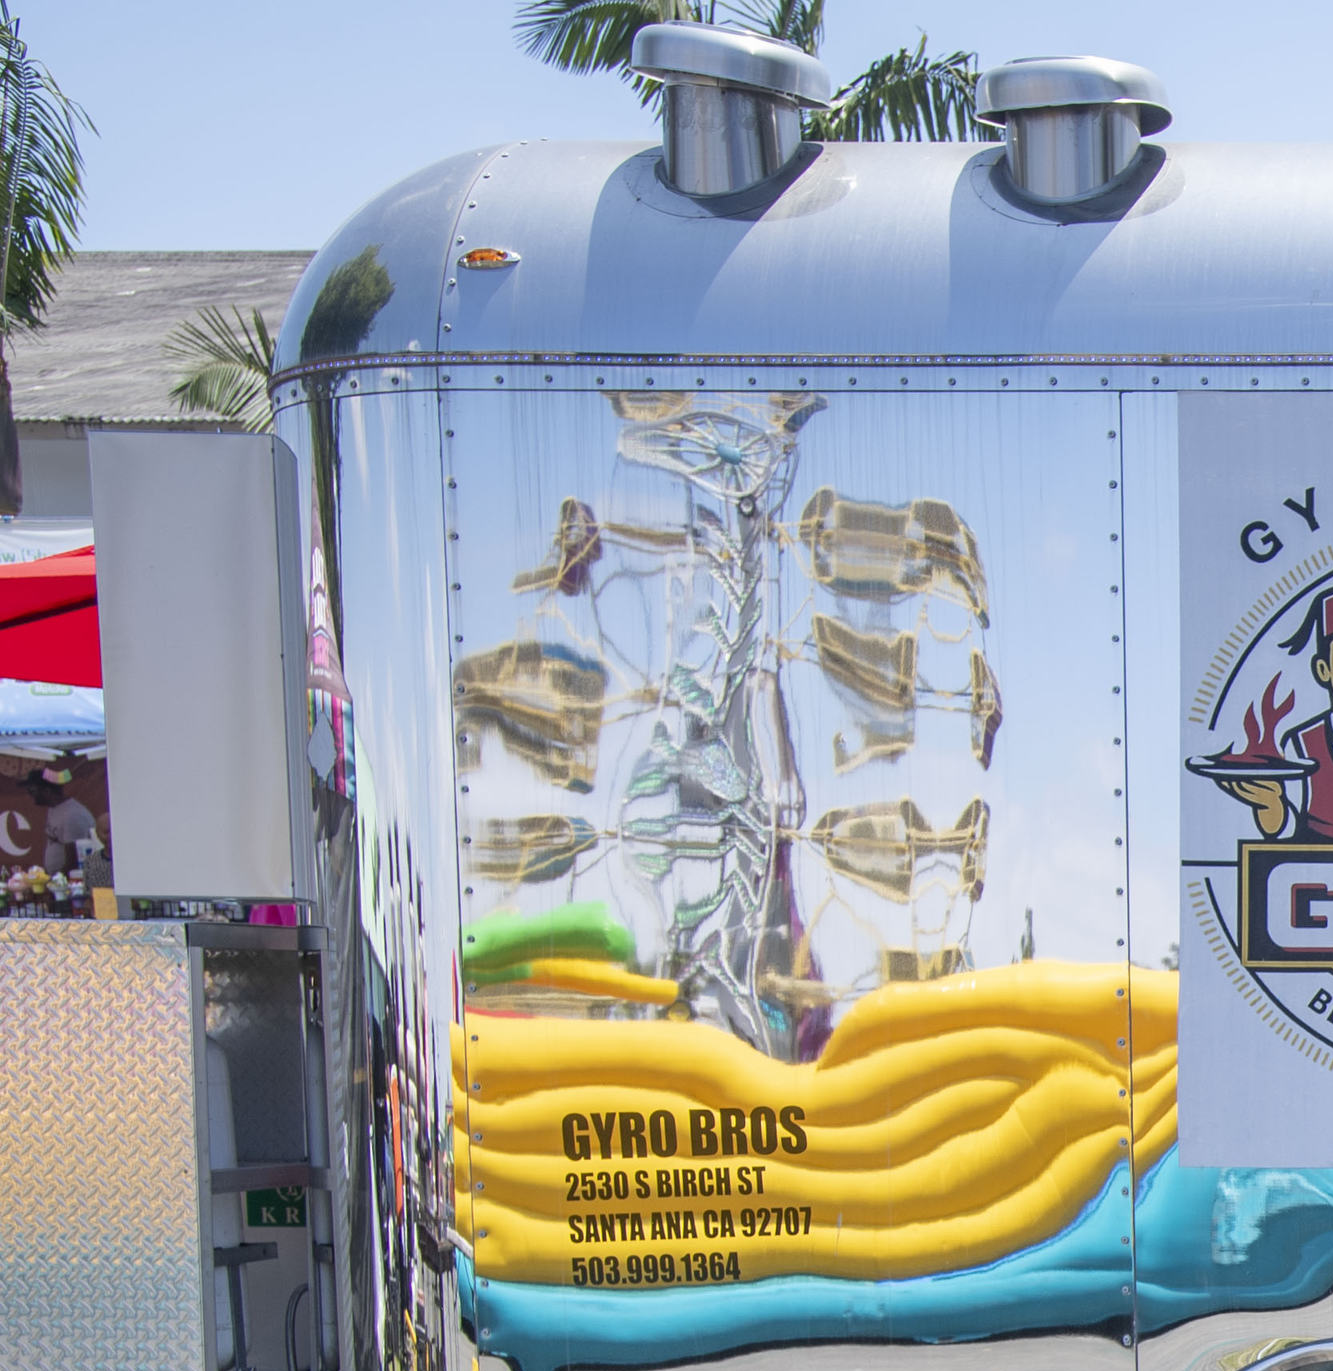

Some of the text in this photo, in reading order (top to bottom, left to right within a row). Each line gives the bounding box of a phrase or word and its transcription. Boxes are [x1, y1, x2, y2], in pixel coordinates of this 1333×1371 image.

[561, 1105, 808, 1161] GYRO BROS
[565, 1166, 766, 1201] 2530 S BIRCH ST
[568, 1206, 813, 1244] SANTA ANA CA 92707
[571, 1251, 741, 1287] 503.999.1364
